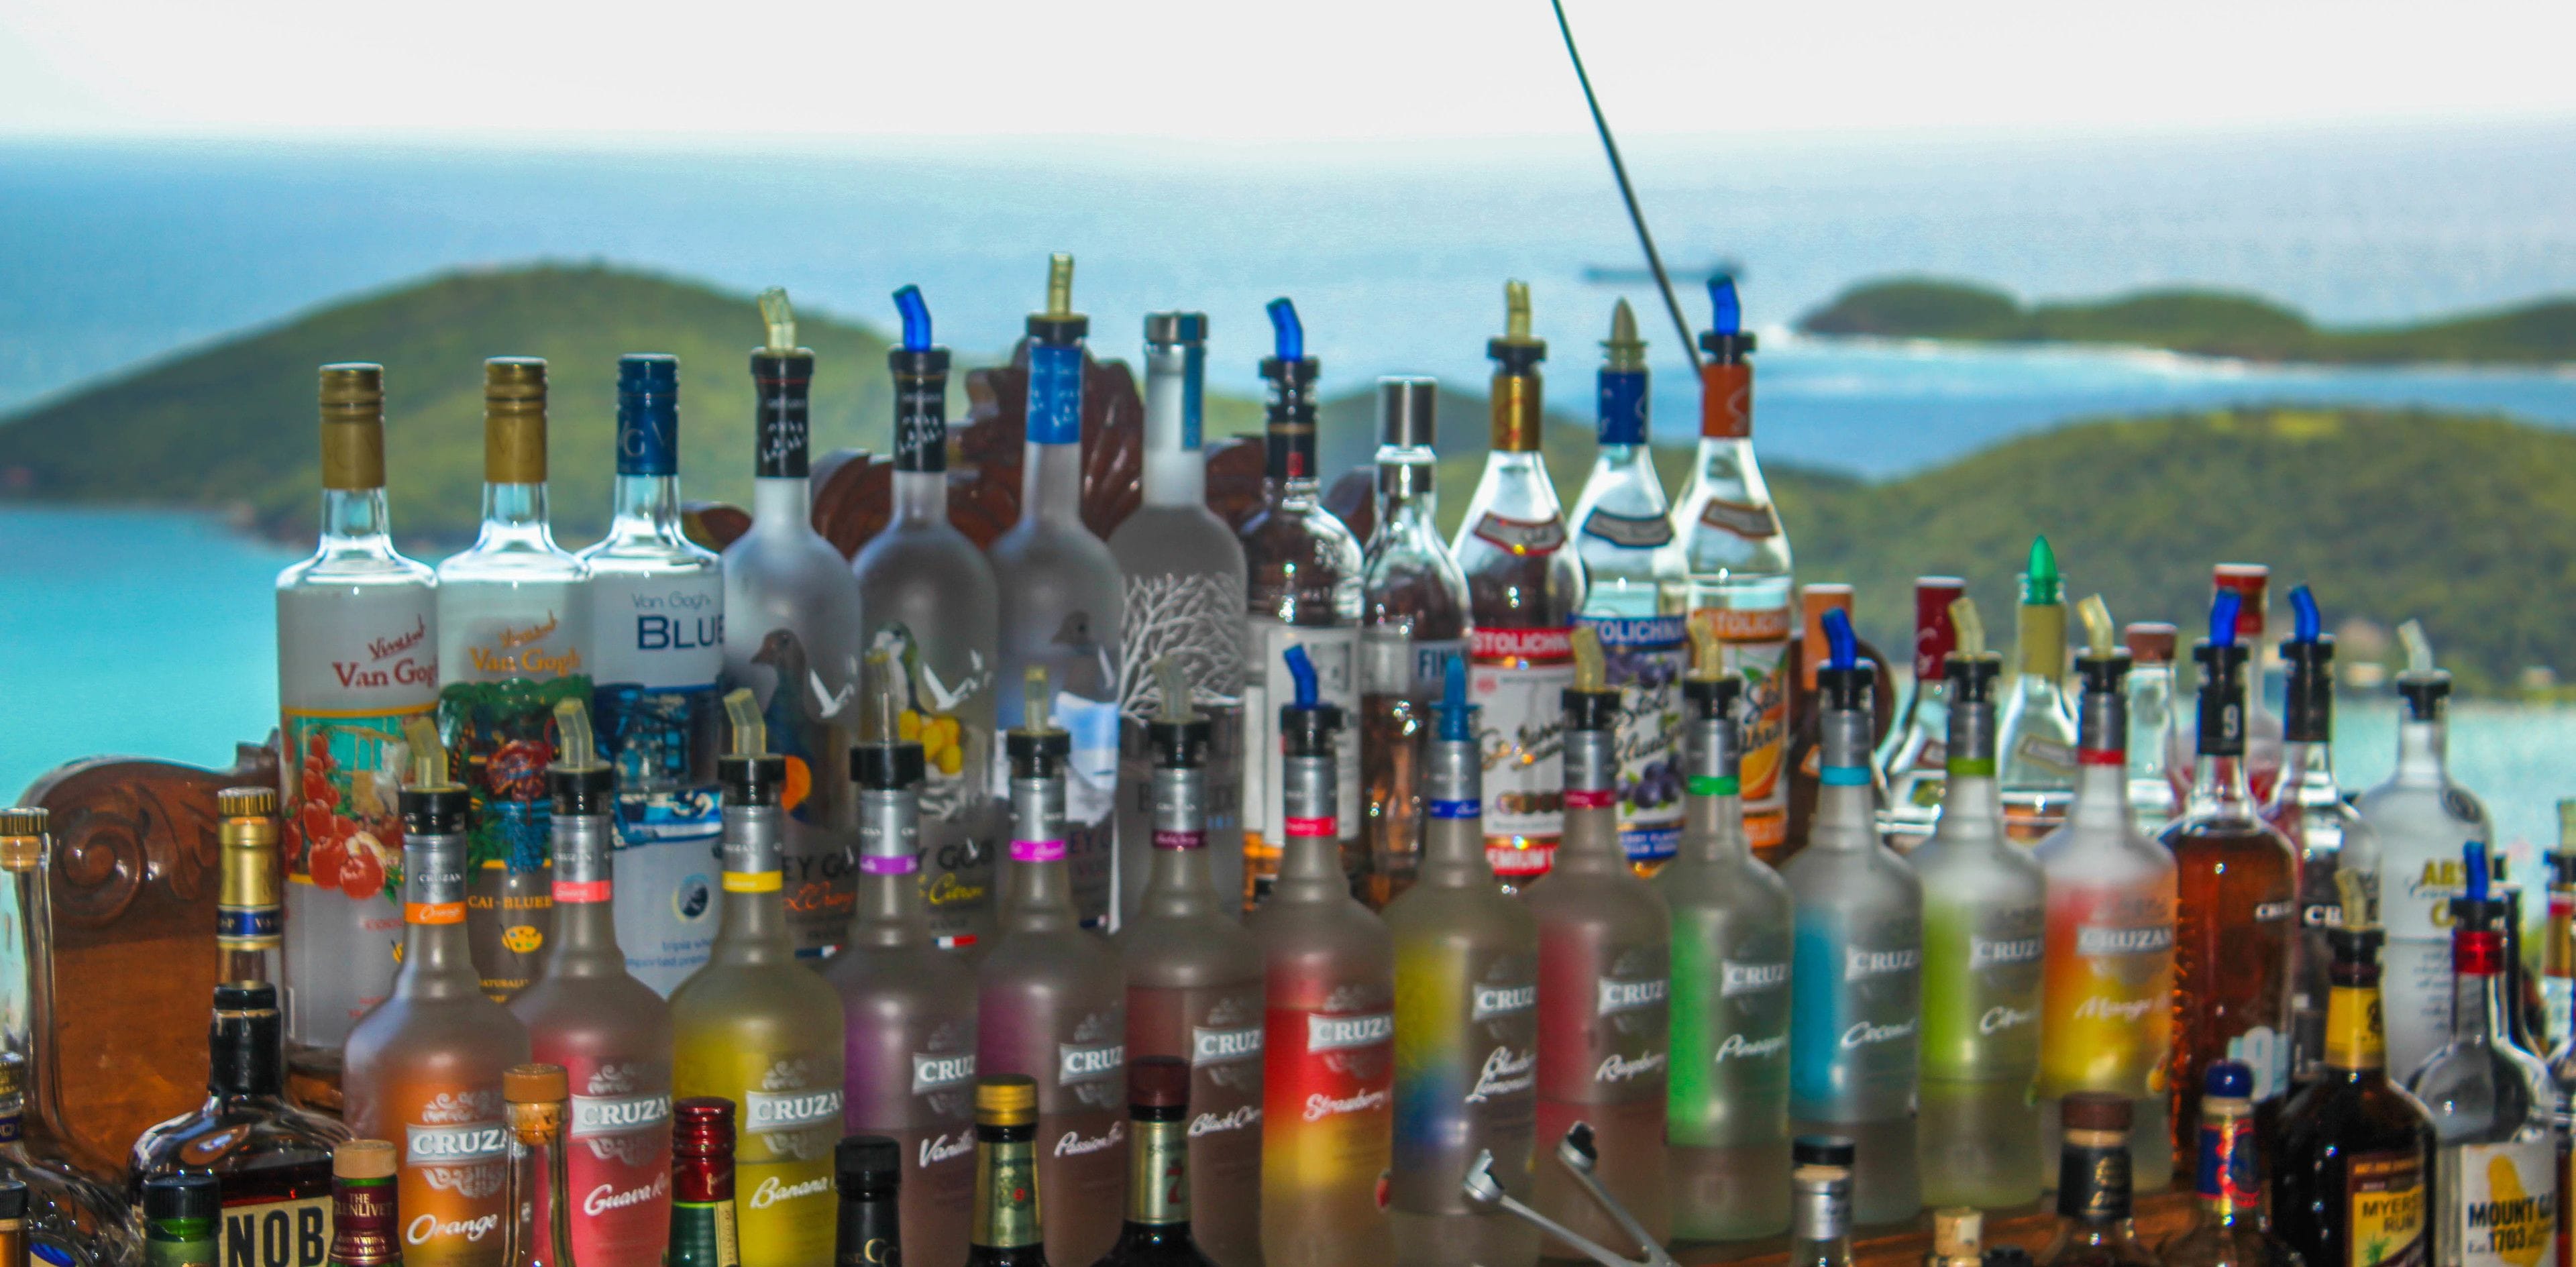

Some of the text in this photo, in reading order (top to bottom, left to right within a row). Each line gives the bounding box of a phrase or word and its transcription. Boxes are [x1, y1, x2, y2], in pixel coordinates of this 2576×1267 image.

[333, 661, 389, 687] Van
[471, 647, 515, 671] Van
[349, 1193, 370, 1204] THE
[583, 1183, 651, 1217] Guava
[749, 1176, 828, 1209] Banana
[2467, 1196, 2536, 1228] MOUNT
[227, 1205, 325, 1267] NOB
[407, 1213, 498, 1246] Orange
[2488, 1225, 2526, 1254] 1703
